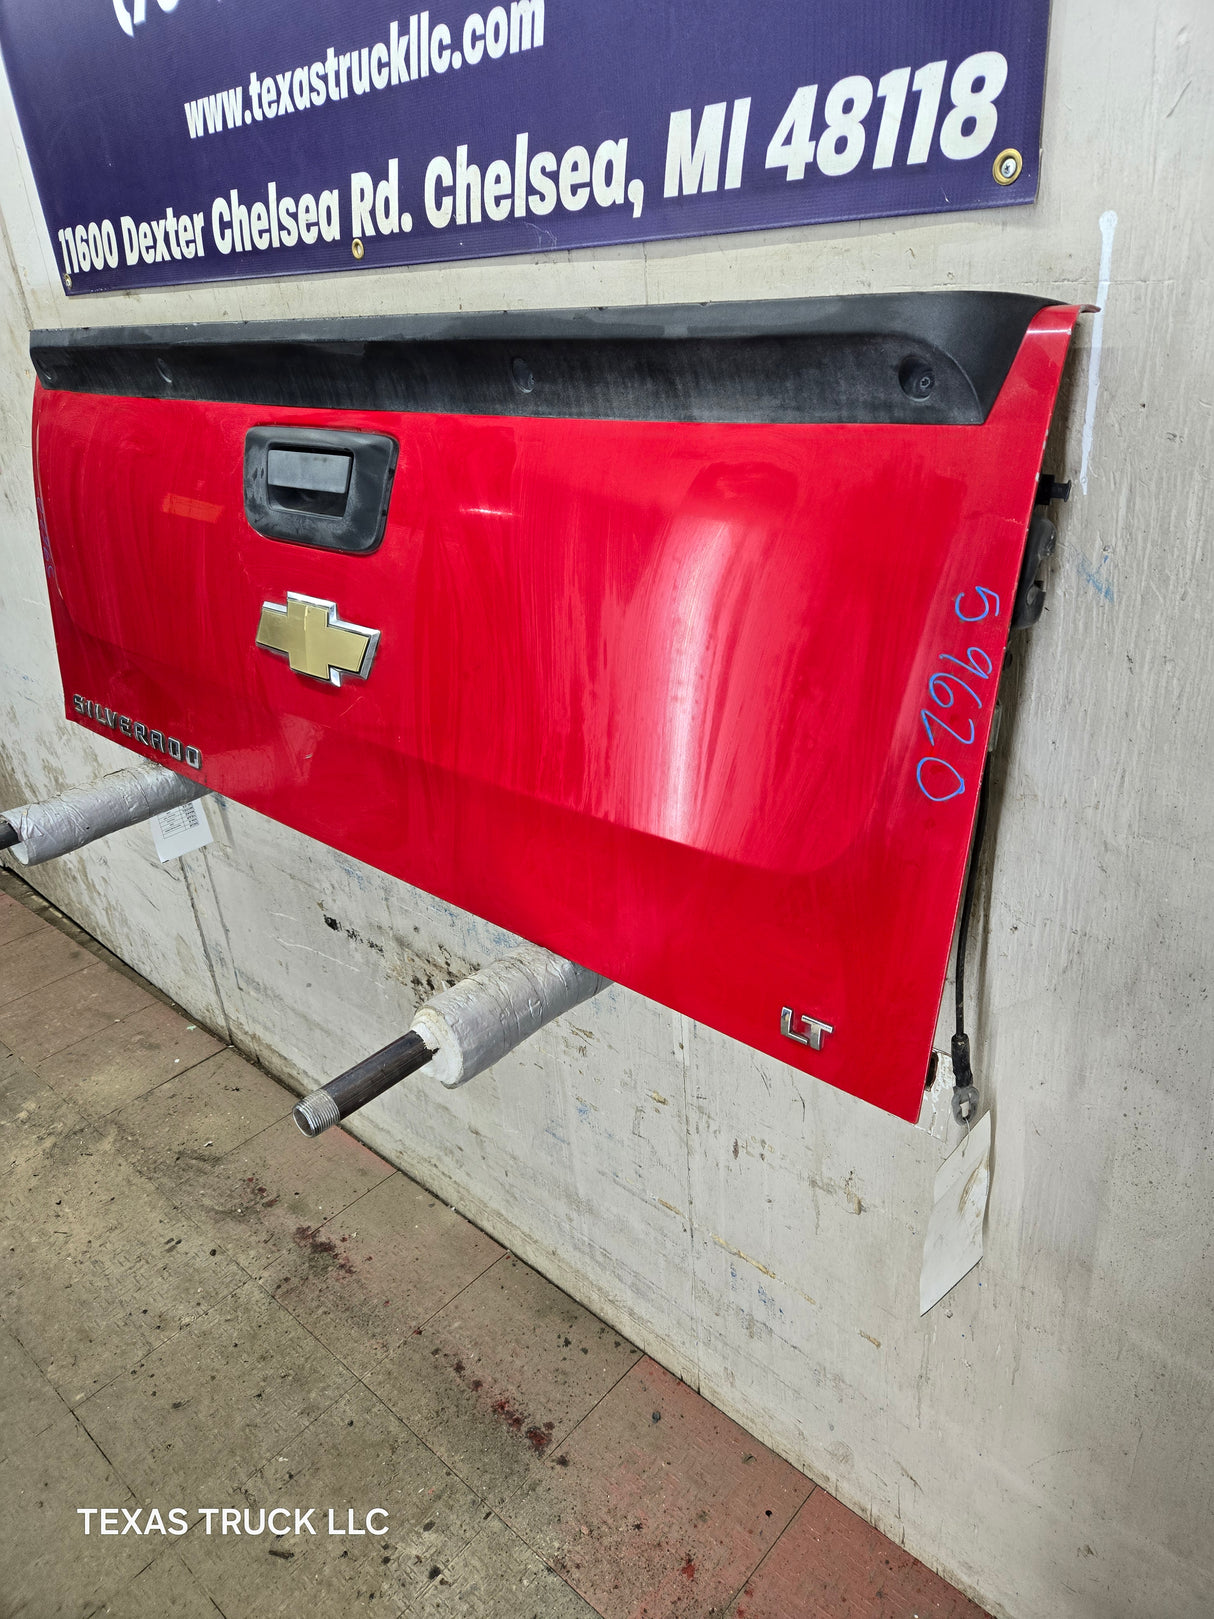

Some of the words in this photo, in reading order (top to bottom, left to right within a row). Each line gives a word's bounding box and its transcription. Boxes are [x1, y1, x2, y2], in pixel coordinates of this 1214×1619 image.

[184, 0, 546, 139] www.texastruckllc.com
[57, 218, 118, 275] 11600
[121, 208, 206, 265] Dexter
[212, 182, 340, 255] Chelsea
[351, 158, 413, 240] Rd.
[424, 132, 644, 229] Chelsea,
[663, 97, 752, 199] MI
[765, 51, 1009, 181] 48118
[73, 694, 202, 770] SILVERADO
[780, 1005, 834, 1051] LT
